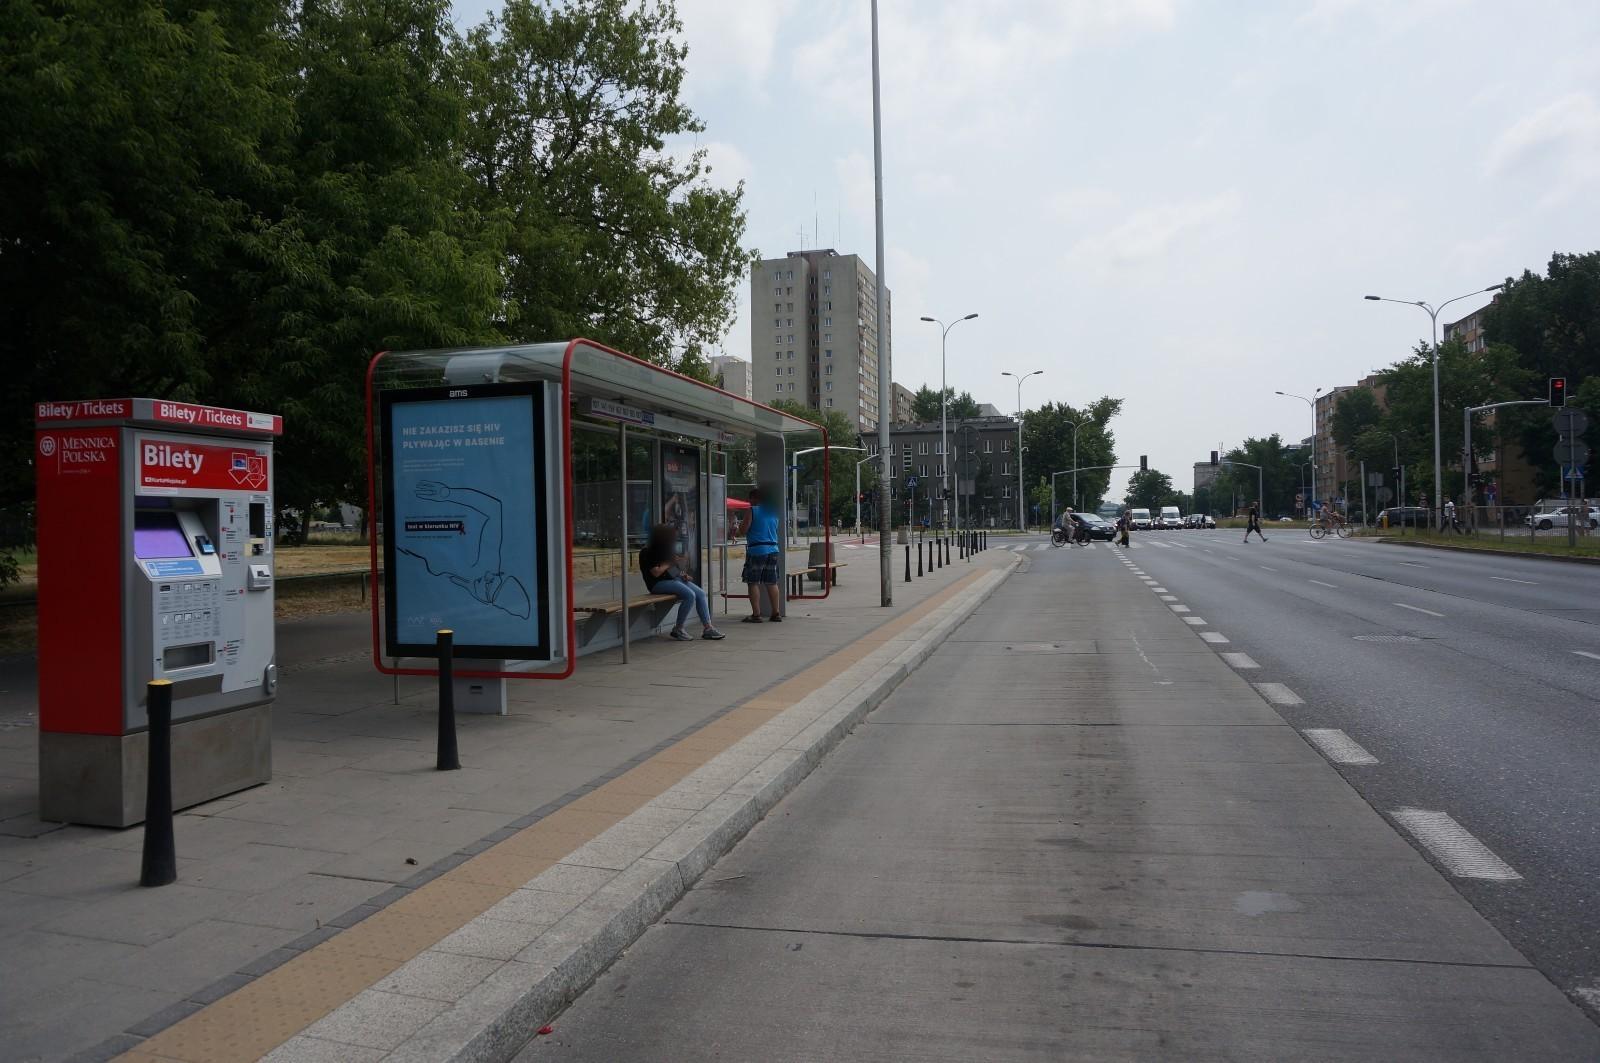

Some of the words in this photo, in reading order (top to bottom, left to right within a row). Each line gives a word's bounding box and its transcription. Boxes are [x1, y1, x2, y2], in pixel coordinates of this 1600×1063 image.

[449, 389, 467, 397] ams
[38, 404, 73, 419] Bilety
[75, 403, 80, 416] /
[82, 402, 124, 415] Tickets
[160, 404, 196, 423] Bilety
[198, 409, 203, 421] /
[204, 409, 242, 425] Tickets
[402, 427, 417, 436] NIE
[466, 424, 481, 434] SIĘ
[483, 423, 501, 432] HIV
[62, 437, 116, 449] MENNICA
[453, 438, 462, 447] W
[465, 436, 505, 446] BASENIE
[62, 450, 106, 463] POLSKA
[144, 444, 204, 474] Bilety
